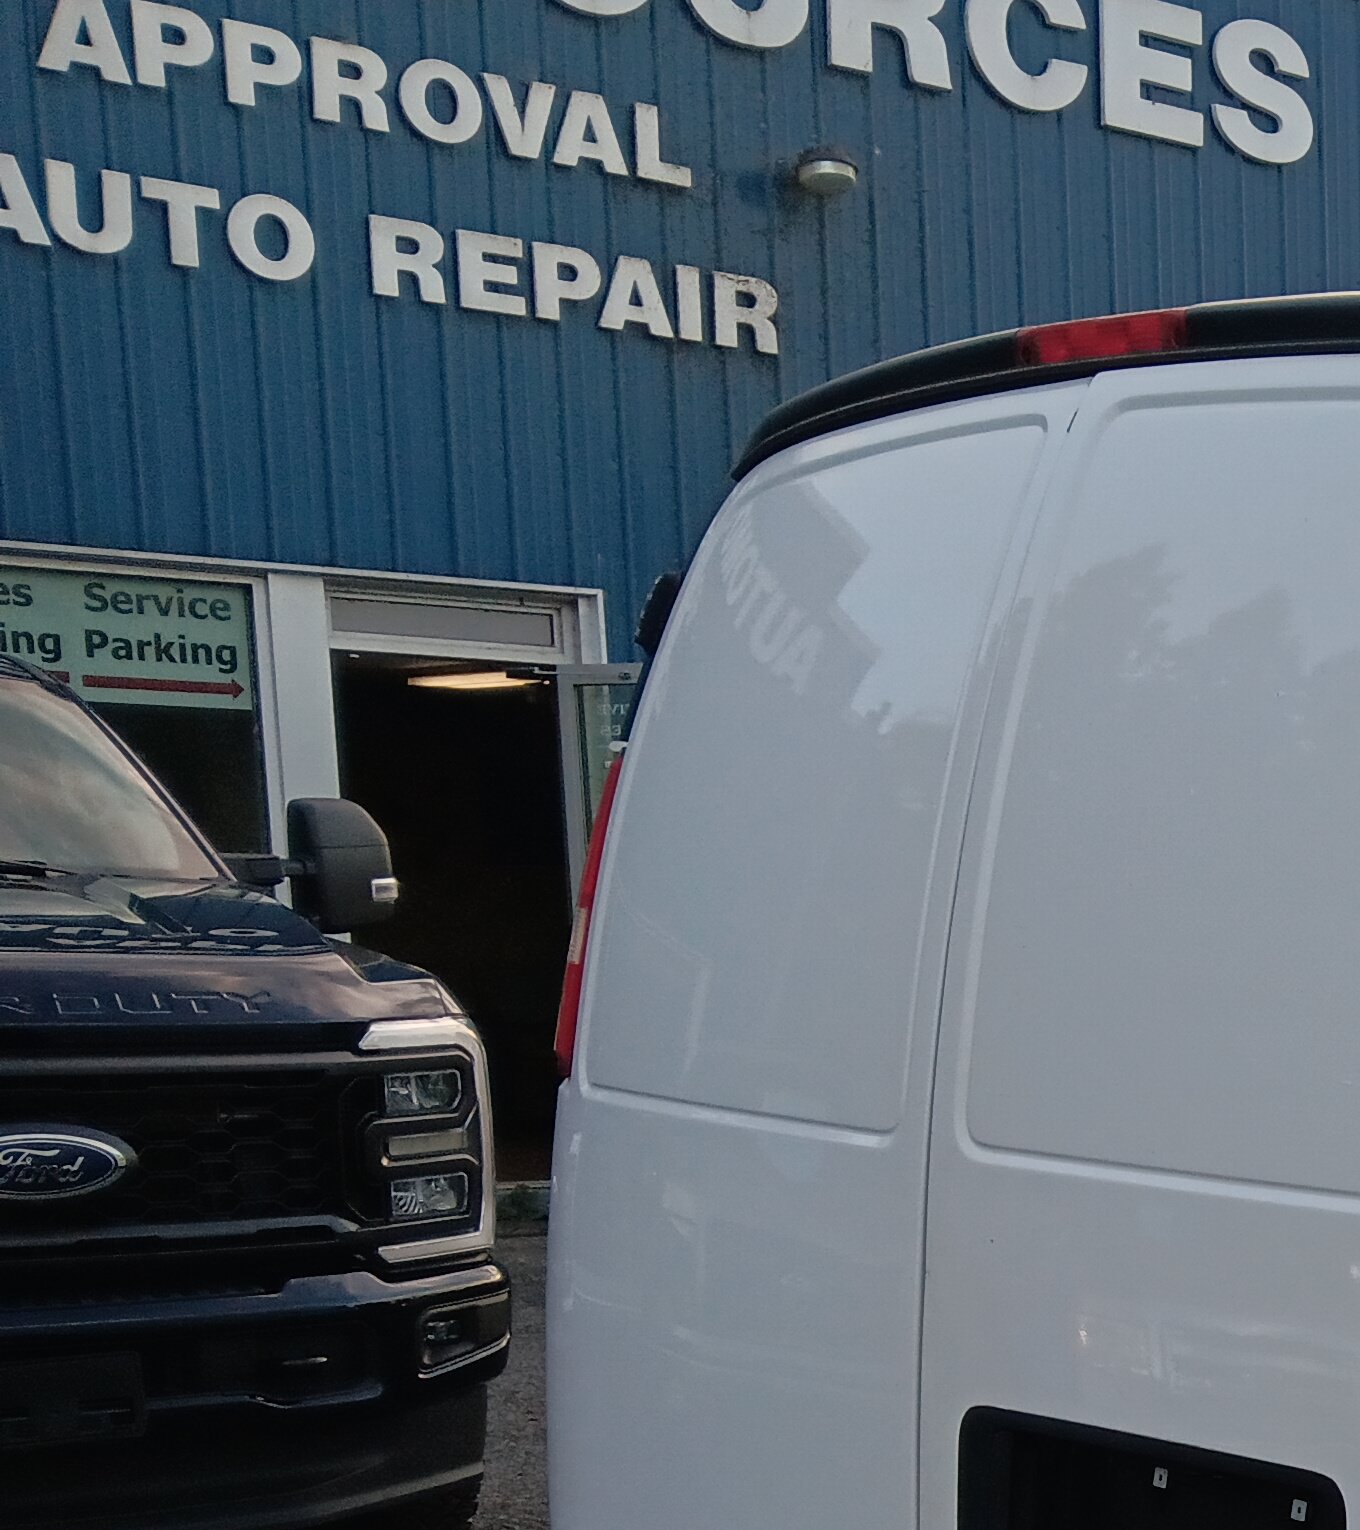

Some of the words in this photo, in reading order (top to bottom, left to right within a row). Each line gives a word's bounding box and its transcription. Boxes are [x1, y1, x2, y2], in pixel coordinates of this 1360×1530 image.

[37, 0, 694, 188] APPROVAL
[545, 0, 1315, 165] RCES
[0, 152, 315, 282] AUTO
[368, 213, 780, 355] REPAIR
[83, 581, 233, 621] Service
[84, 628, 238, 674] Parking
[52, 990, 272, 1015] DUTY
[0, 1148, 85, 1184] Ford
